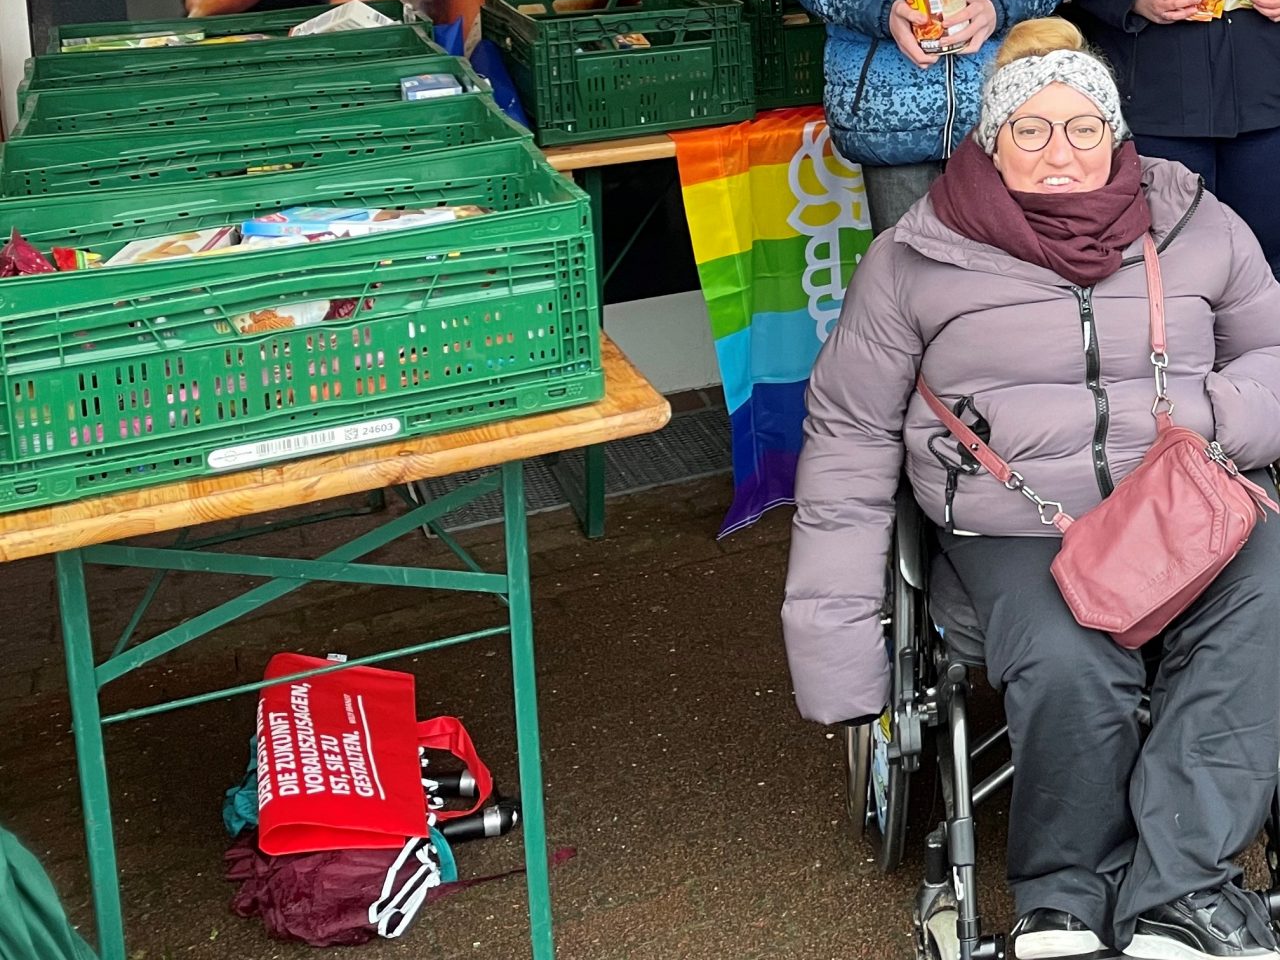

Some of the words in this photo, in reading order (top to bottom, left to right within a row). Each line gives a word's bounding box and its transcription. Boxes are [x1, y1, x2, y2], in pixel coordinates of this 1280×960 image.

[362, 422, 394, 436] 24603
[268, 711, 296, 771] ZUKUNFT
[290, 683, 325, 794] VORAUSZUSAGEN,
[320, 734, 340, 753] ZU
[323, 753, 345, 772] SIE
[342, 731, 374, 797] GESTALTEN.
[277, 771, 300, 796] DIE
[329, 774, 351, 795] IST,
